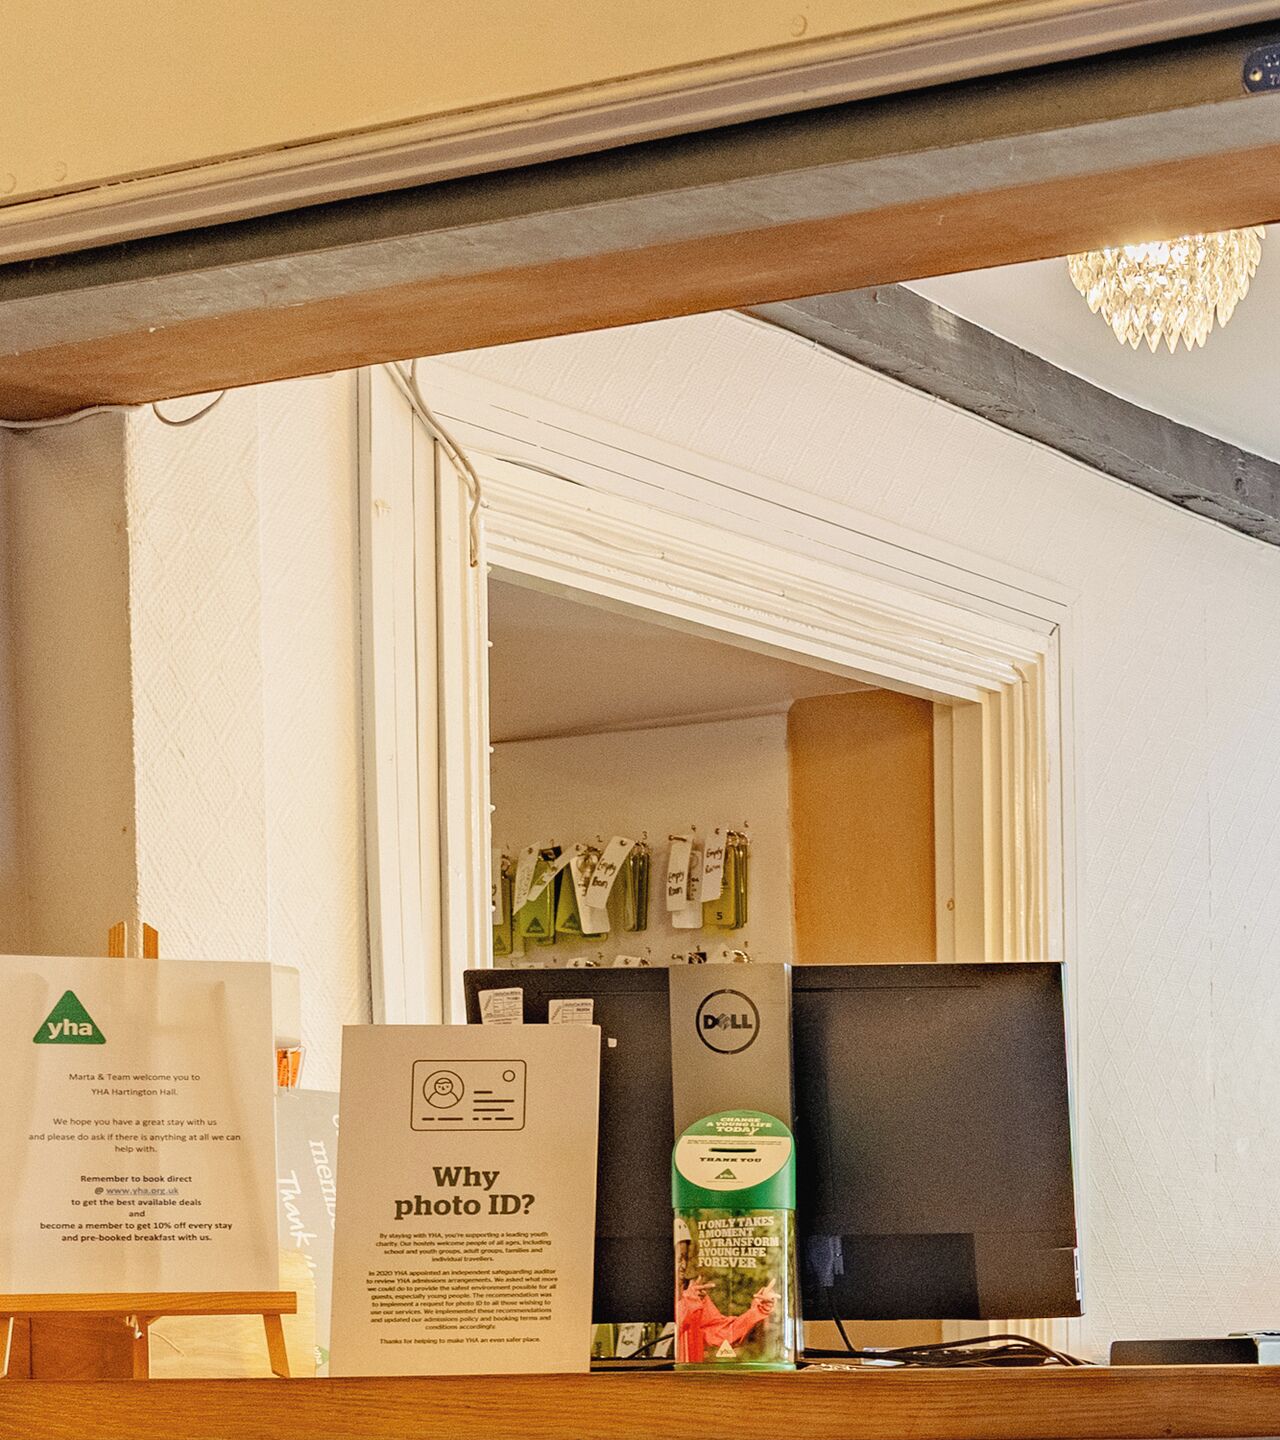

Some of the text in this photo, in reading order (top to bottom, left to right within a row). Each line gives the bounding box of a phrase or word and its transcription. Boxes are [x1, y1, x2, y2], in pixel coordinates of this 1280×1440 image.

[716, 911, 723, 920] 5
[703, 1013, 753, 1030] DELL
[47, 1018, 93, 1039] yha
[68, 1073, 201, 1083] Marta & Team welcome you to
[90, 1088, 178, 1098] YHA Hartington Hall.
[52, 1117, 68, 1126] We
[69, 1117, 92, 1128] hope
[93, 1119, 110, 1128] you
[111, 1117, 133, 1126] have
[141, 1117, 165, 1128] great
[166, 1117, 185, 1128] stay
[185, 1117, 205, 1126] with
[716, 1126, 760, 1136] TODAY
[28, 1133, 45, 1141] and
[46, 1133, 75, 1143] please
[76, 1133, 89, 1141] do
[90, 1133, 105, 1141] ask
[106, 1133, 113, 1141] if
[114, 1133, 139, 1141] there
[139, 1133, 148, 1141] is
[148, 1133, 187, 1143] anything
[187, 1133, 197, 1141] at
[198, 1133, 209, 1141] all
[114, 1145, 158, 1154] help with.
[80, 1175, 193, 1183] Remember to book direct
[432, 1166, 500, 1192] Why
[94, 1186, 179, 1196] @ www.yha.org.uk
[71, 1198, 202, 1208] to get the best available deals
[394, 1194, 535, 1220] photo ID?
[128, 1210, 146, 1218] and
[276, 1170, 318, 1248] Thank
[39, 1221, 75, 1229] become
[84, 1221, 123, 1229] member
[124, 1221, 135, 1229] to
[136, 1221, 151, 1231] get
[153, 1221, 172, 1229] 10%
[173, 1221, 186, 1229] off
[187, 1223, 212, 1231] every
[214, 1221, 233, 1231] stay
[697, 1216, 775, 1230] IT ONLY TAKES
[705, 1227, 754, 1238] MOMENT
[60, 1233, 78, 1241] and
[80, 1233, 132, 1243] pre-booked
[133, 1233, 175, 1241] breakfast
[177, 1233, 197, 1241] with
[699, 1237, 780, 1248] TO TRANSFORM
[705, 1247, 740, 1257] YOUNG
[740, 1247, 767, 1257] LIFE
[698, 1257, 757, 1268] FOREVER
